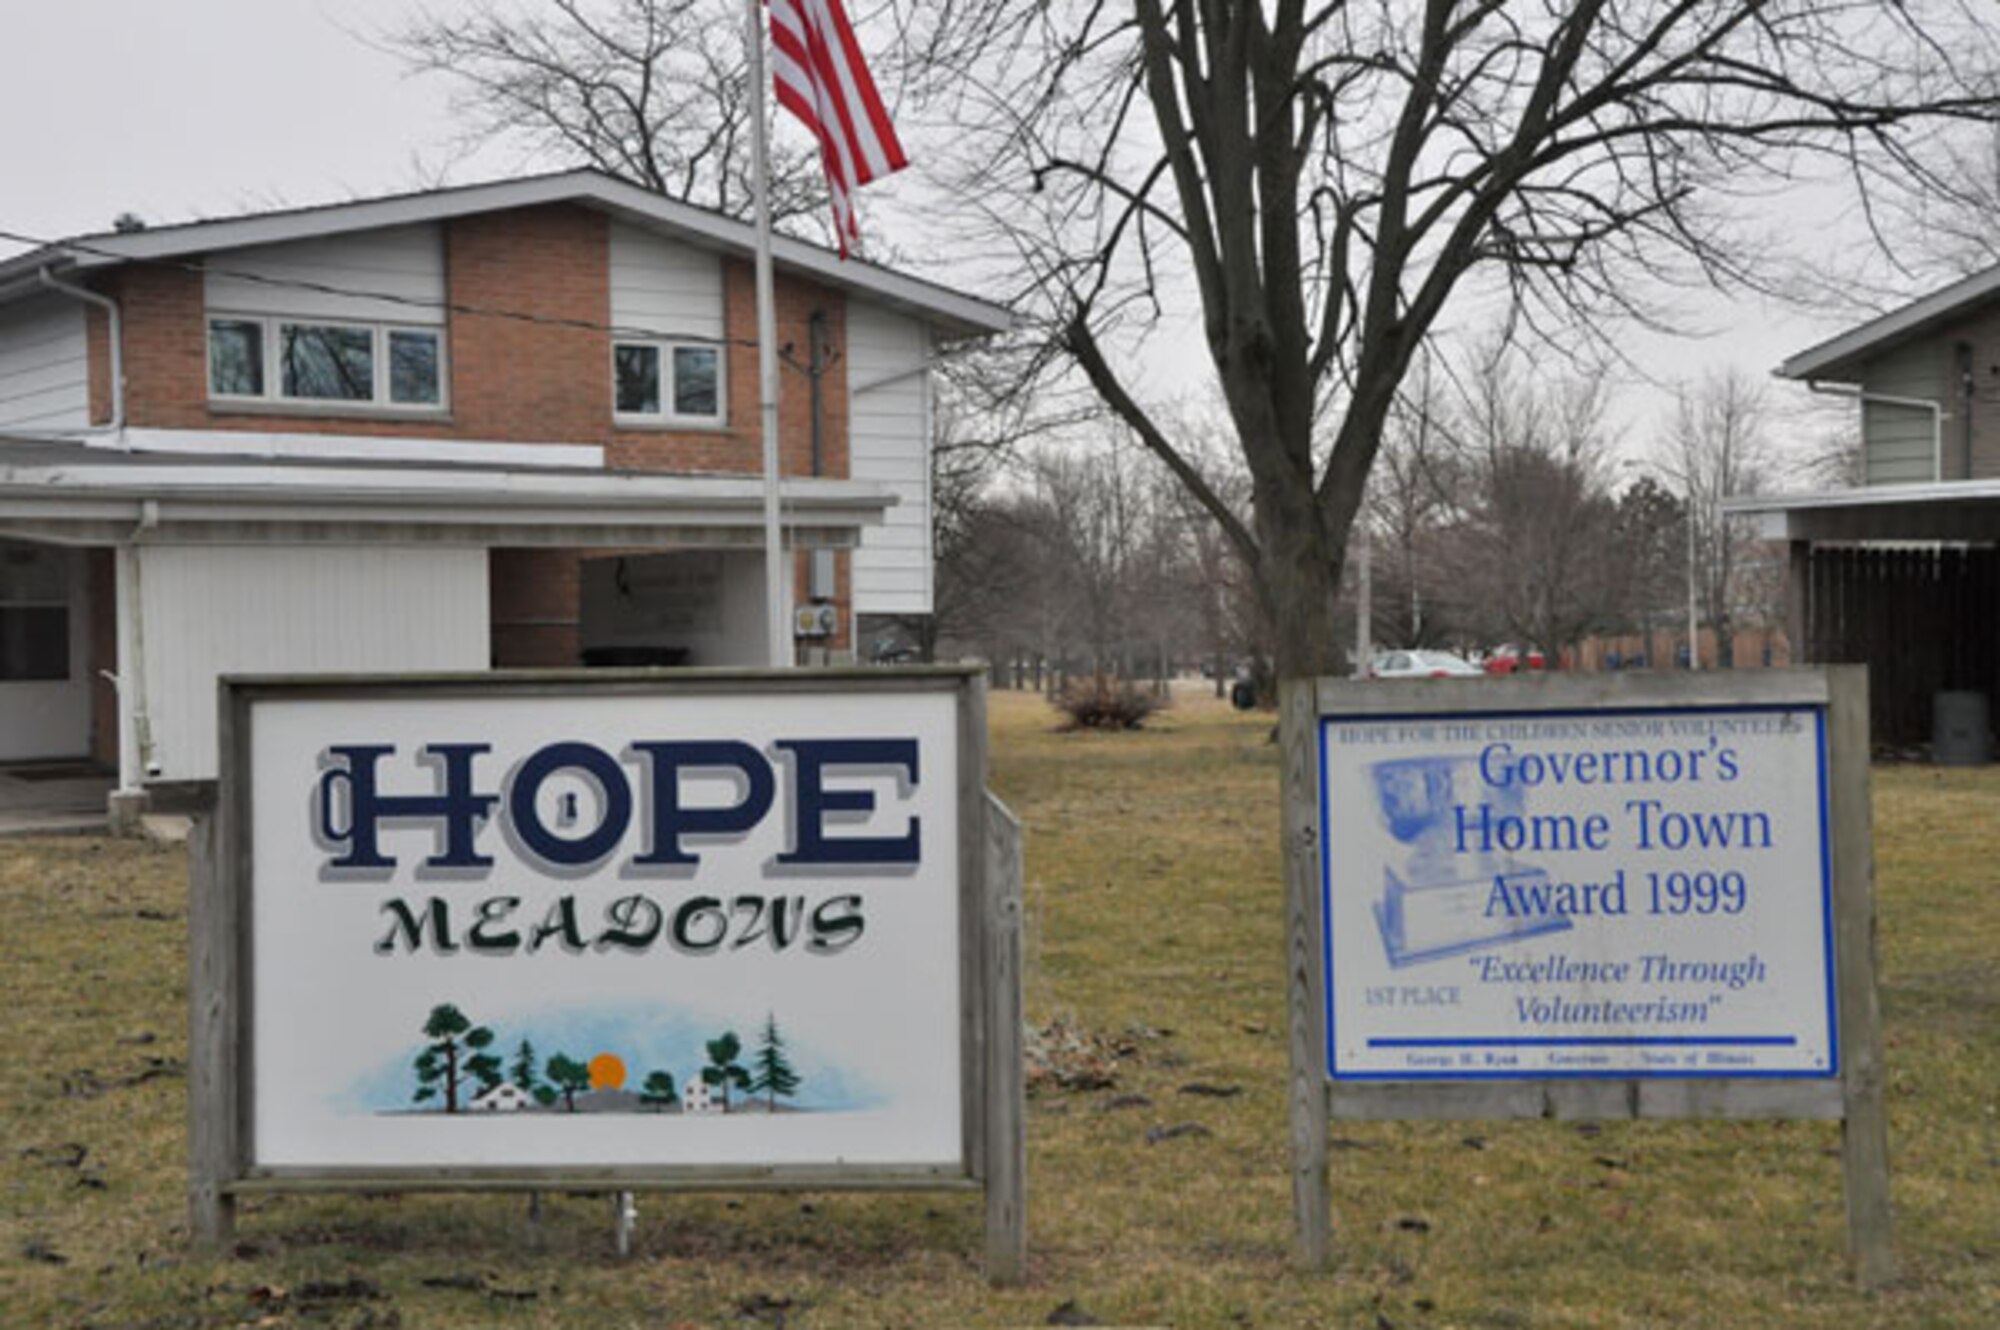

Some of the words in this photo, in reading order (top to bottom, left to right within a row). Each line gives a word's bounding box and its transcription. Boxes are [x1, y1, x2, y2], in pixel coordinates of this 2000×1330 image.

[1339, 725, 1389, 744] HOPE
[1398, 725, 1435, 743] FOR
[1444, 724, 1478, 742] THE
[1479, 736, 1739, 788] Governor's
[311, 739, 921, 880] HOPE
[1453, 802, 1610, 853] Home
[1626, 799, 1774, 851] Town
[1484, 869, 1629, 917] Award
[1645, 871, 1747, 915] 1999
[375, 895, 867, 956] MEADOWS
[1364, 986, 1398, 1007] 1ST
[1400, 985, 1462, 1007] PLACE
[1468, 955, 1630, 985] "Excellence
[1638, 954, 1767, 990] Through
[1514, 992, 1723, 1025] Volunteerism"
